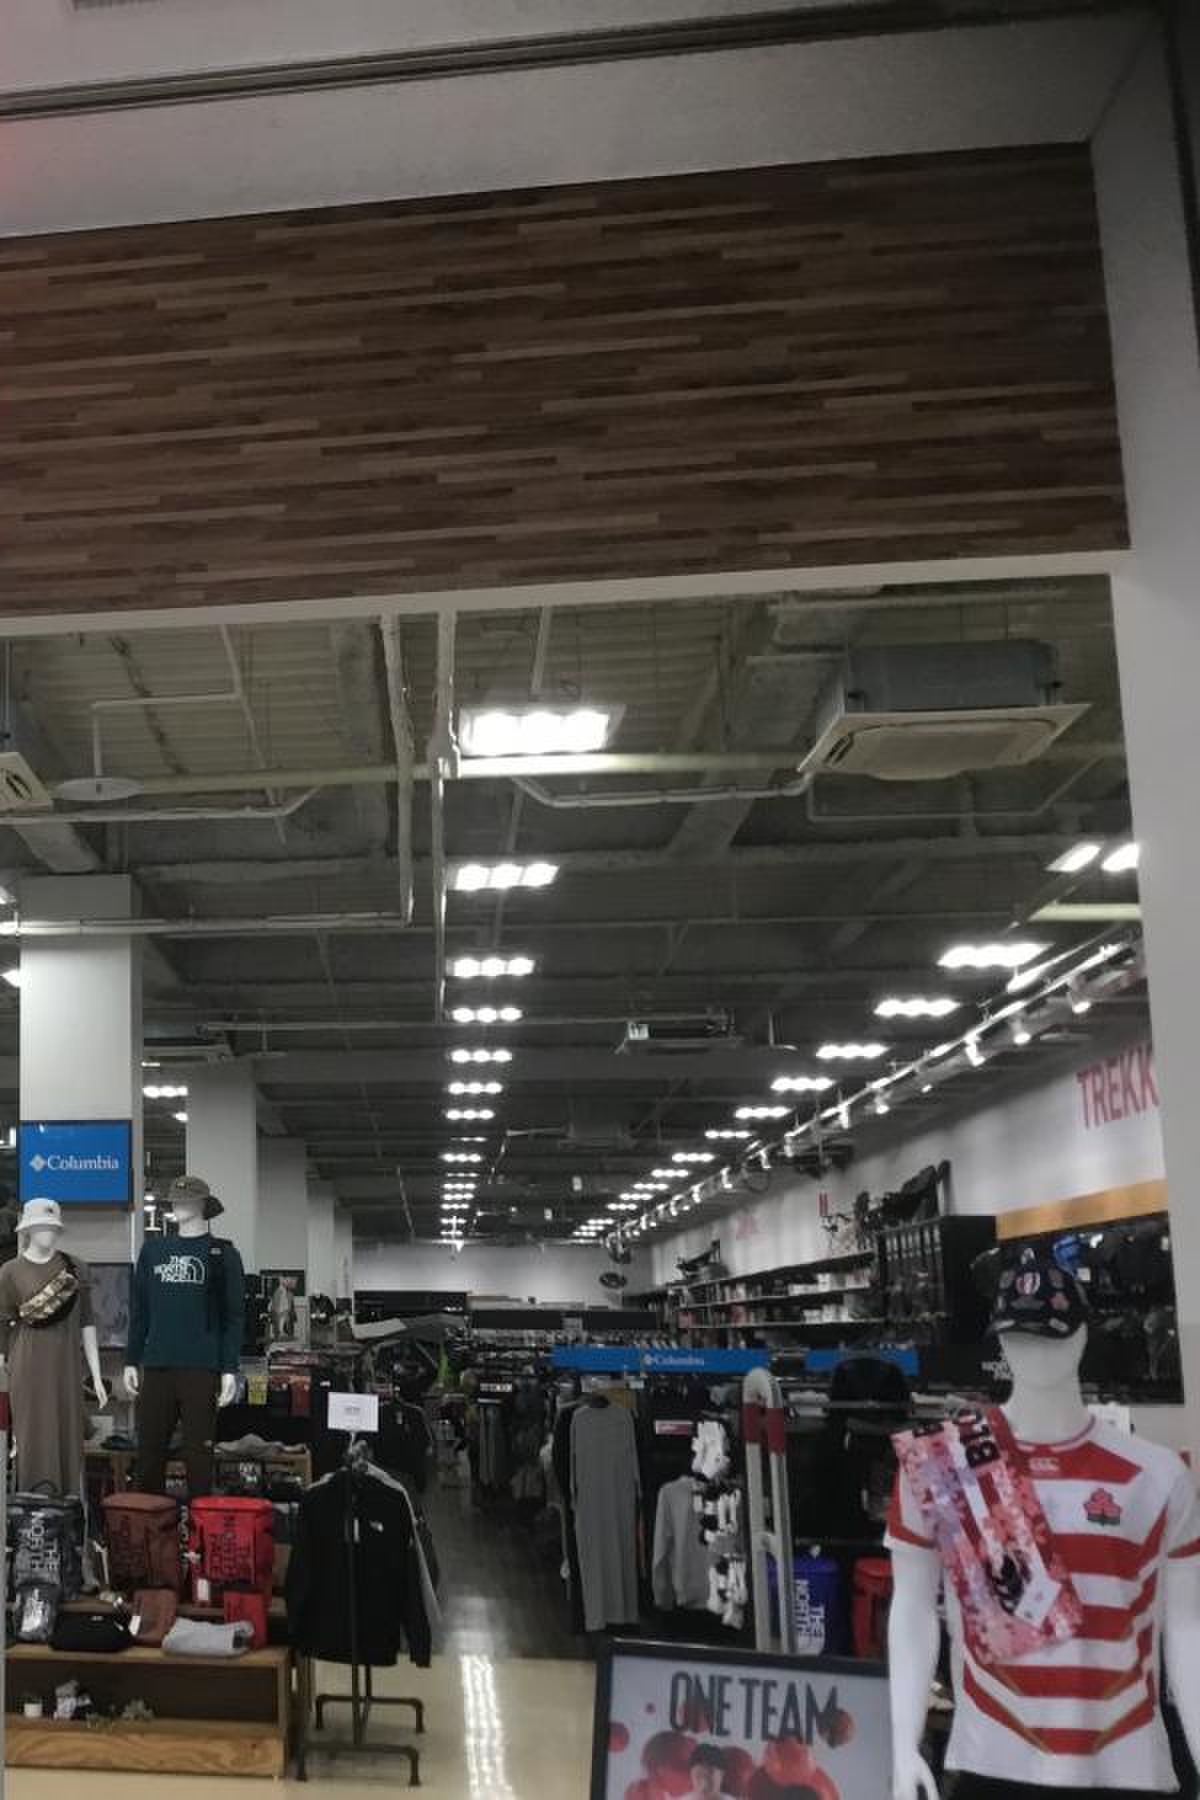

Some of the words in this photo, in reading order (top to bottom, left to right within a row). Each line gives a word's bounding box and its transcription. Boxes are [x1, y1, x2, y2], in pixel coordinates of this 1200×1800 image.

[1077, 1043, 1160, 1128] TREKK
[47, 1155, 120, 1170] Columbia
[669, 1671, 733, 1737] ONE
[739, 1677, 839, 1748] TEAM
